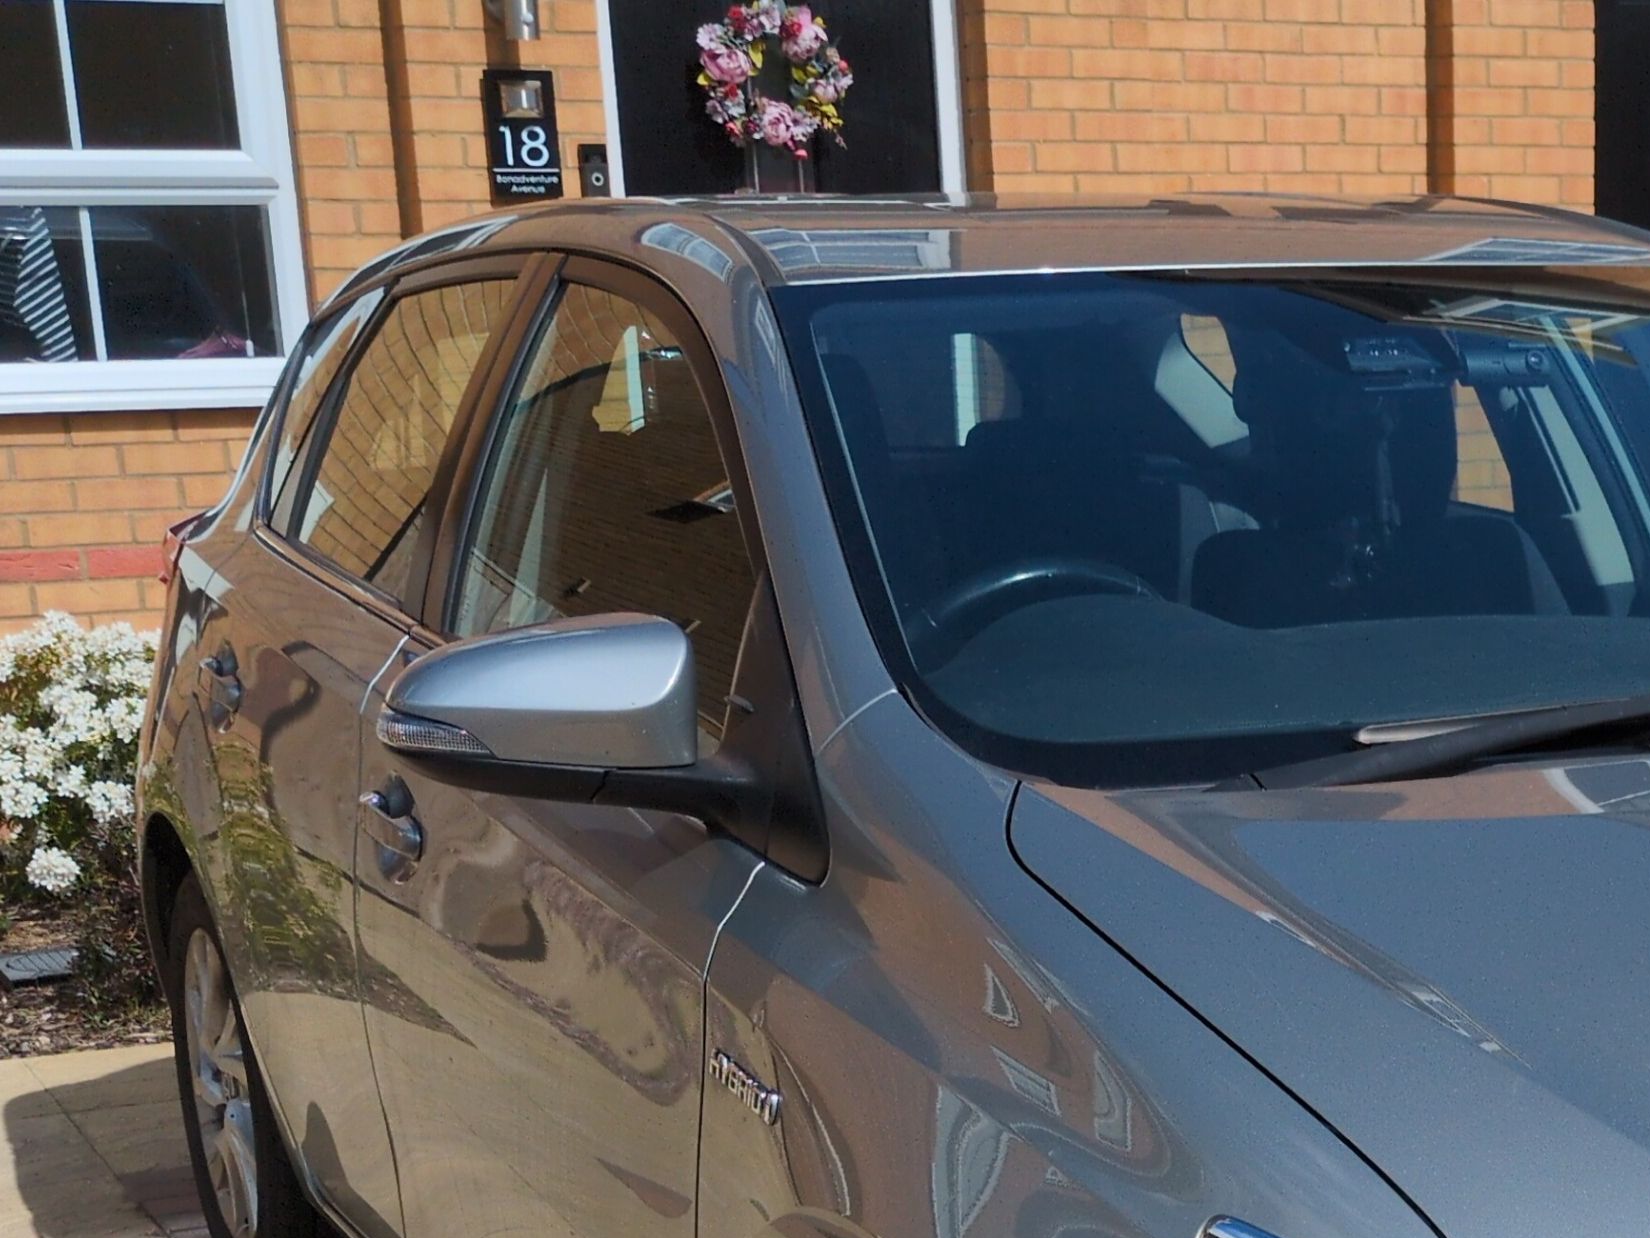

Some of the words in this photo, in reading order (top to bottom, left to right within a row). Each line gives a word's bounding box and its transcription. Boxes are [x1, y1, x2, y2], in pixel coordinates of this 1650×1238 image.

[499, 125, 550, 167] 18
[511, 184, 545, 193] Avenue
[709, 1047, 764, 1115] HYBRID
